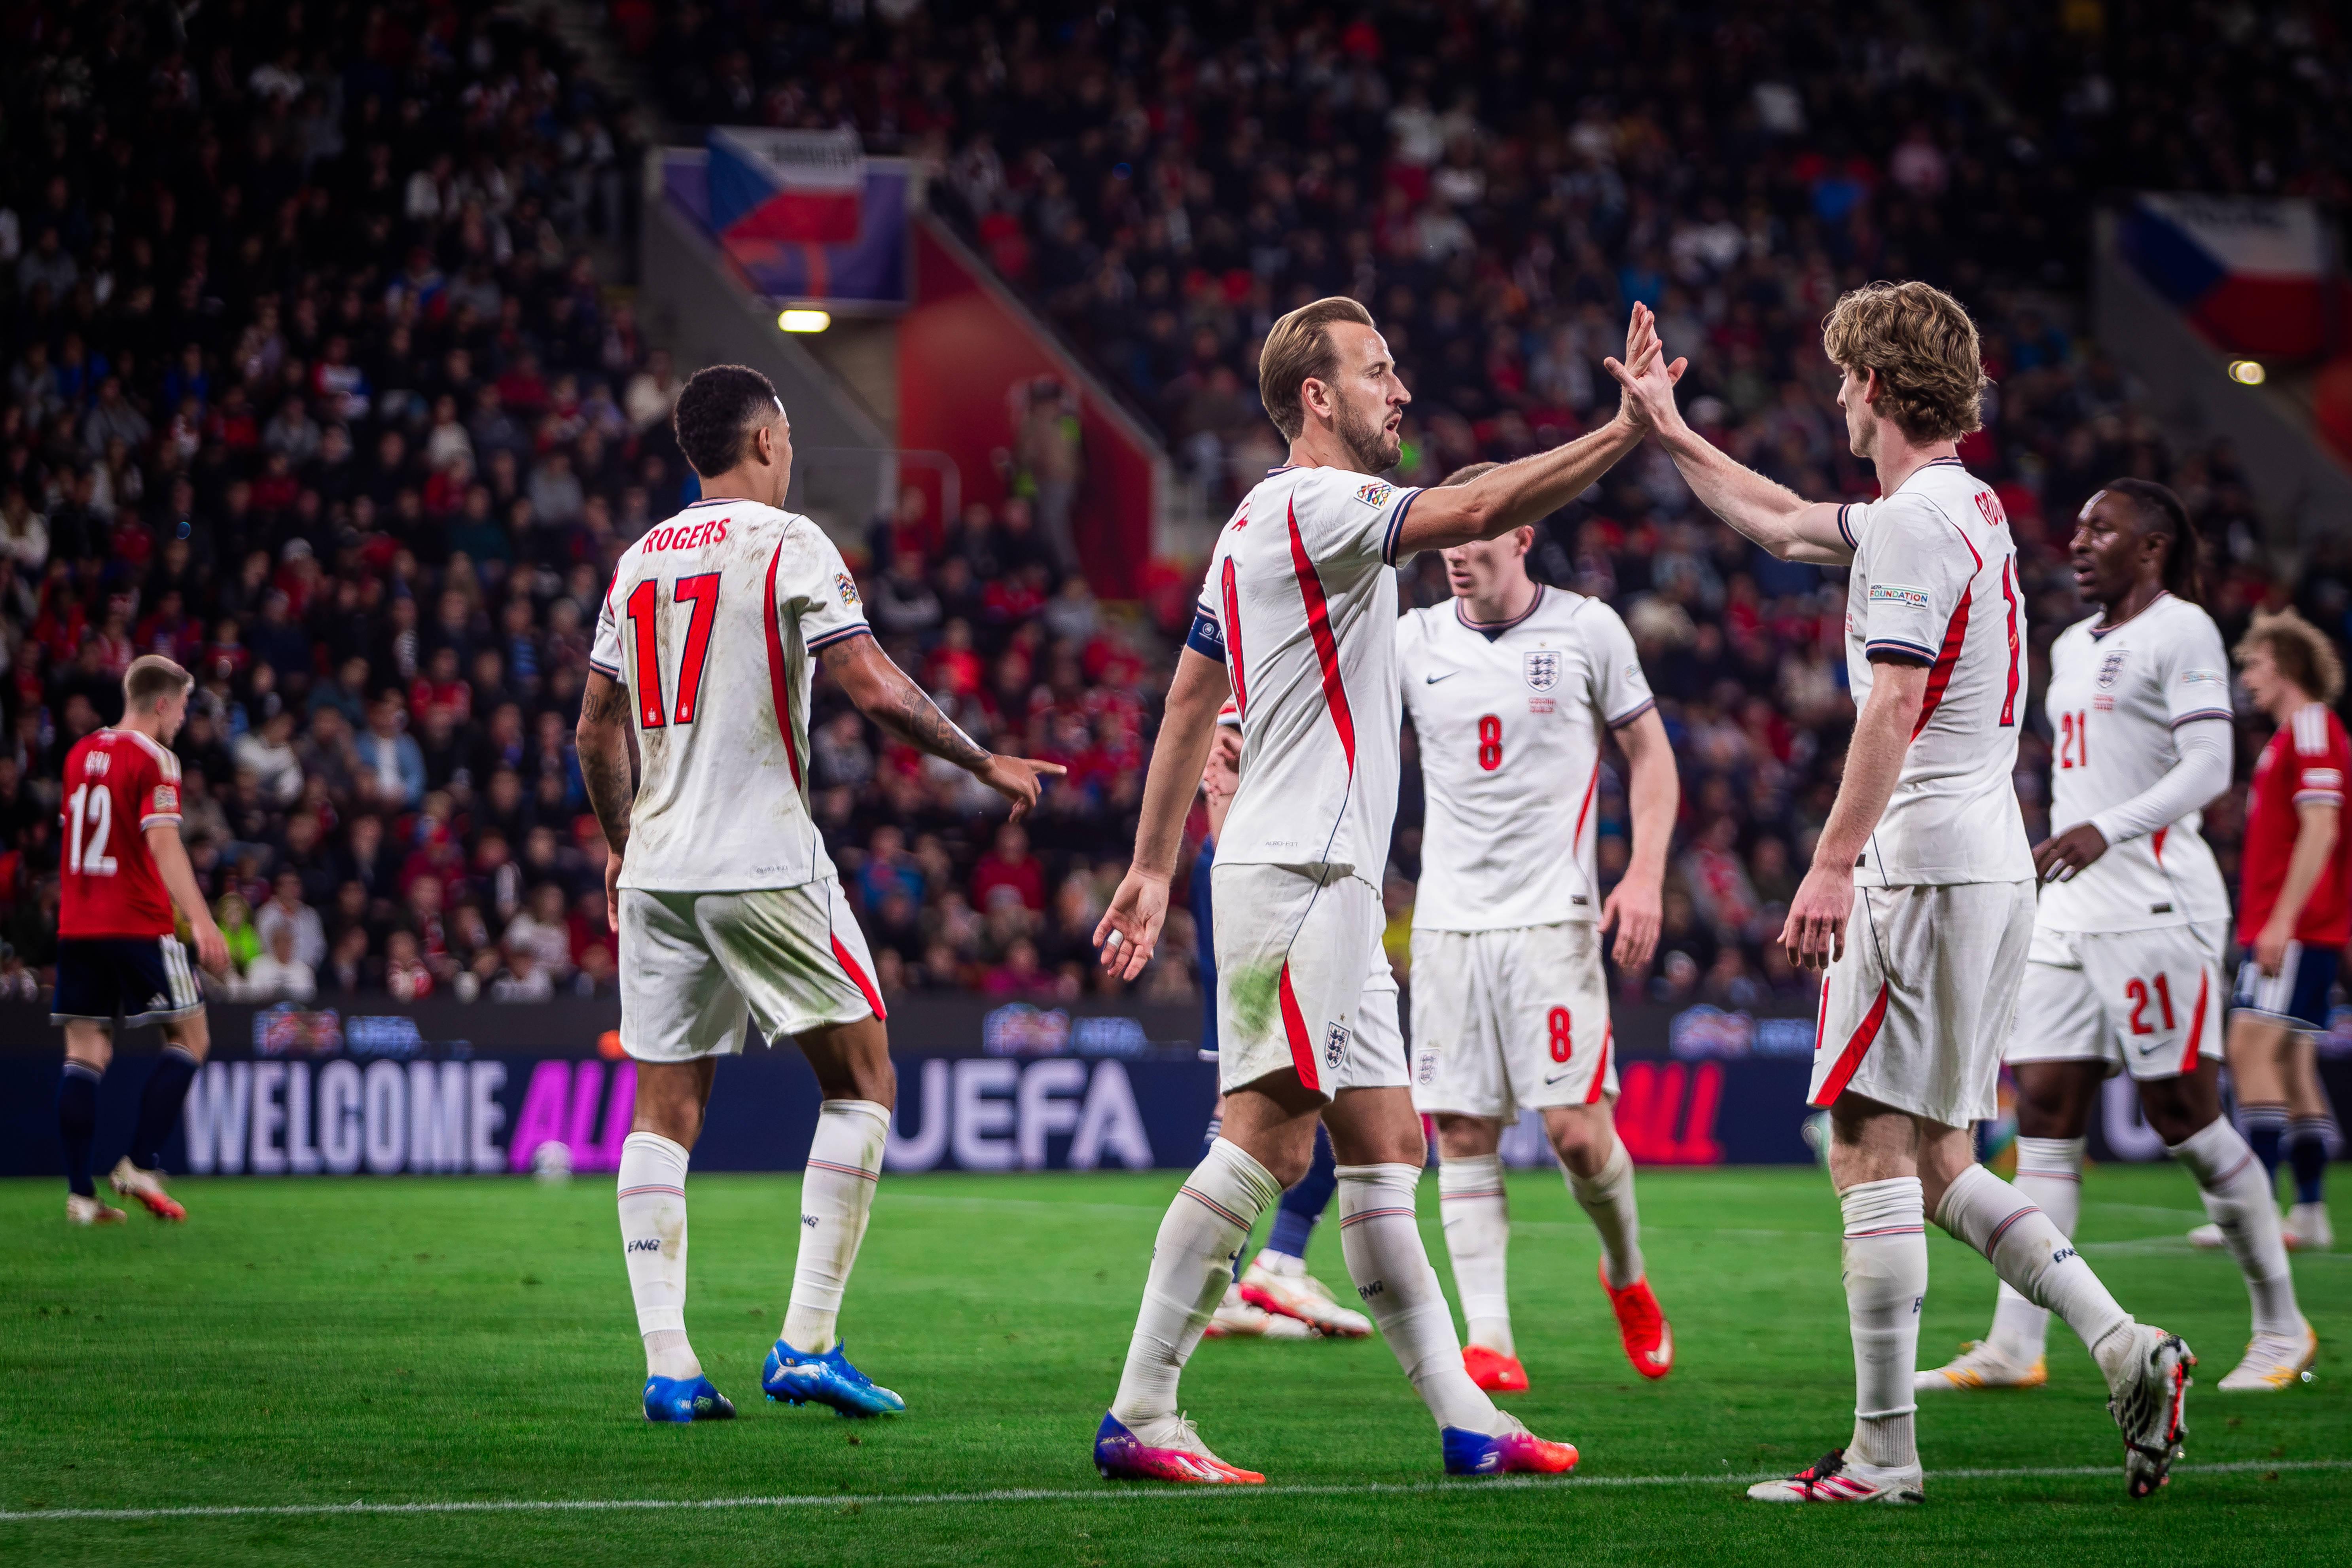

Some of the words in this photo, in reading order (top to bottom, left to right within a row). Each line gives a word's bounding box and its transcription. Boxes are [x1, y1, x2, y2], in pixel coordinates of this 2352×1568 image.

[642, 517, 731, 555] ROGERS
[1870, 590, 1928, 603] FOUNDATION
[627, 571, 722, 730] 17
[1478, 714, 1502, 771] 8
[2061, 710, 2087, 769] 21
[68, 783, 118, 876] 12
[2125, 972, 2175, 1035] 21
[1547, 1006, 1572, 1063] 8
[184, 1059, 507, 1173] WELCOME
[881, 1058, 1156, 1172] UEFA
[628, 1239, 660, 1253] ENG
[801, 1215, 819, 1228] NG
